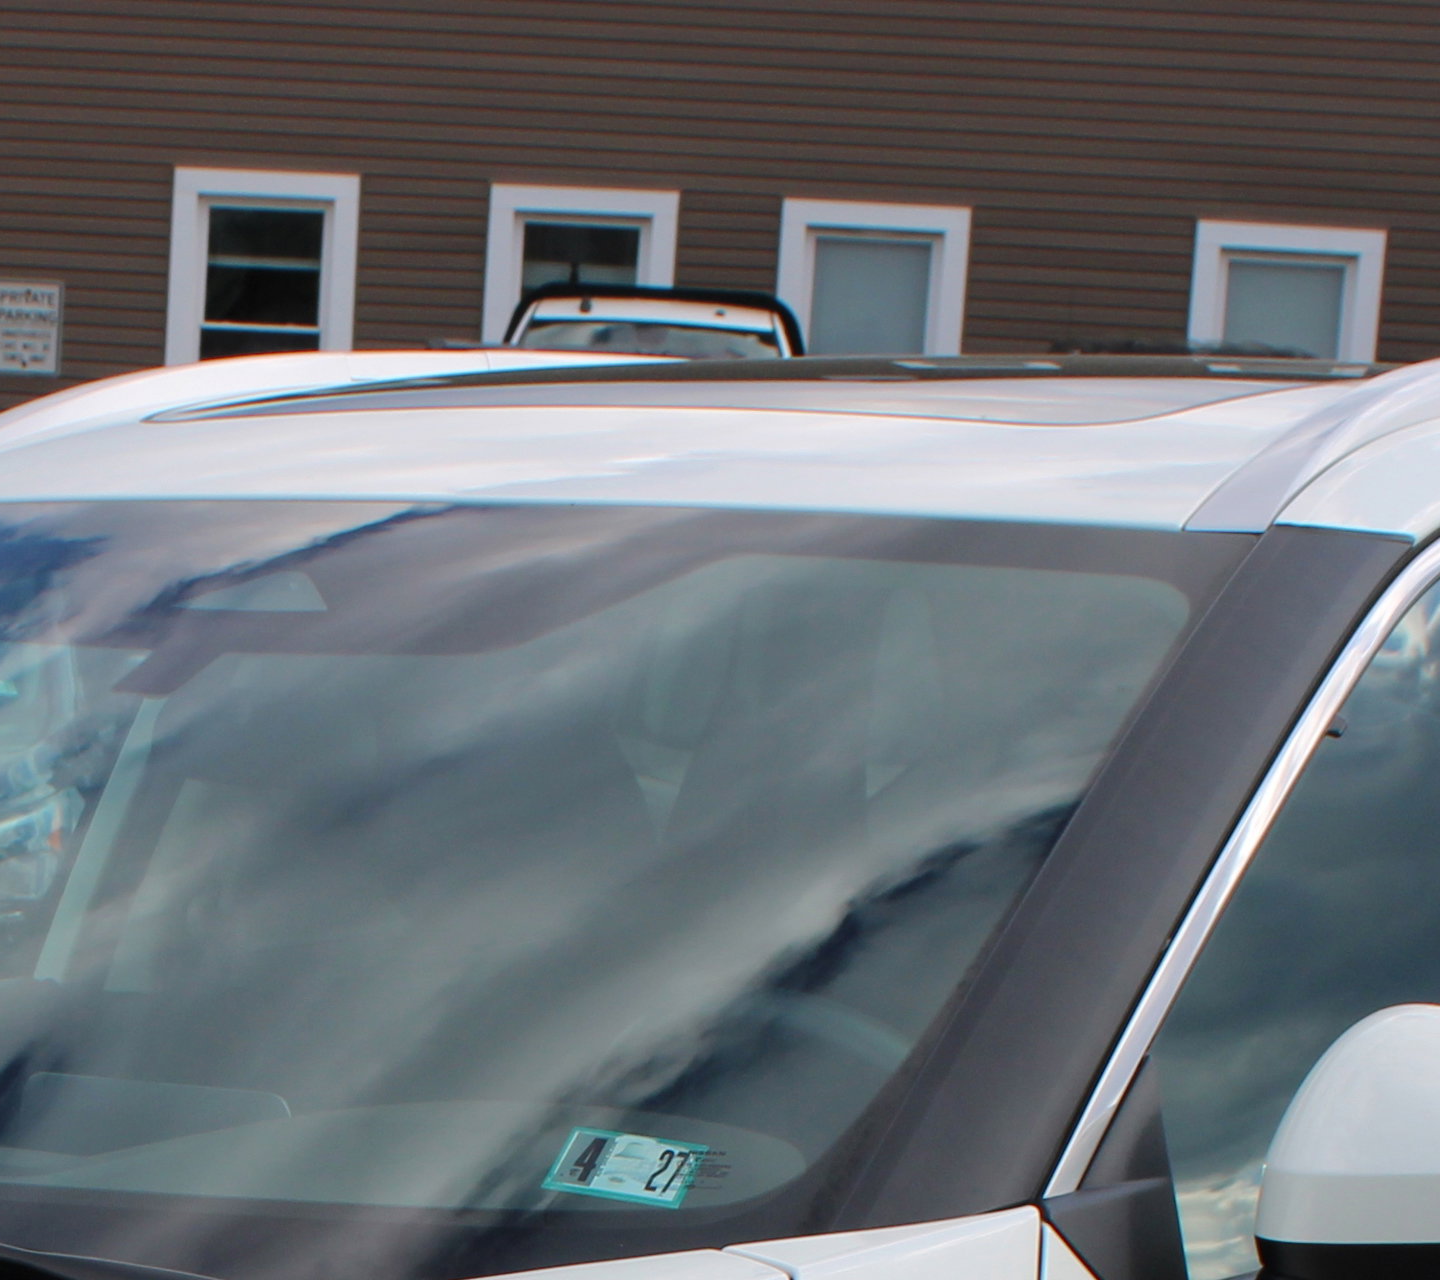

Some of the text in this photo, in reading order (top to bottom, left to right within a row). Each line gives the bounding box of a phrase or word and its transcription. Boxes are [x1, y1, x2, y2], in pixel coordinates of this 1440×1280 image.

[0, 289, 55, 307] PRIVATE
[573, 1137, 608, 1182] 4
[644, 1149, 691, 1194] 27
